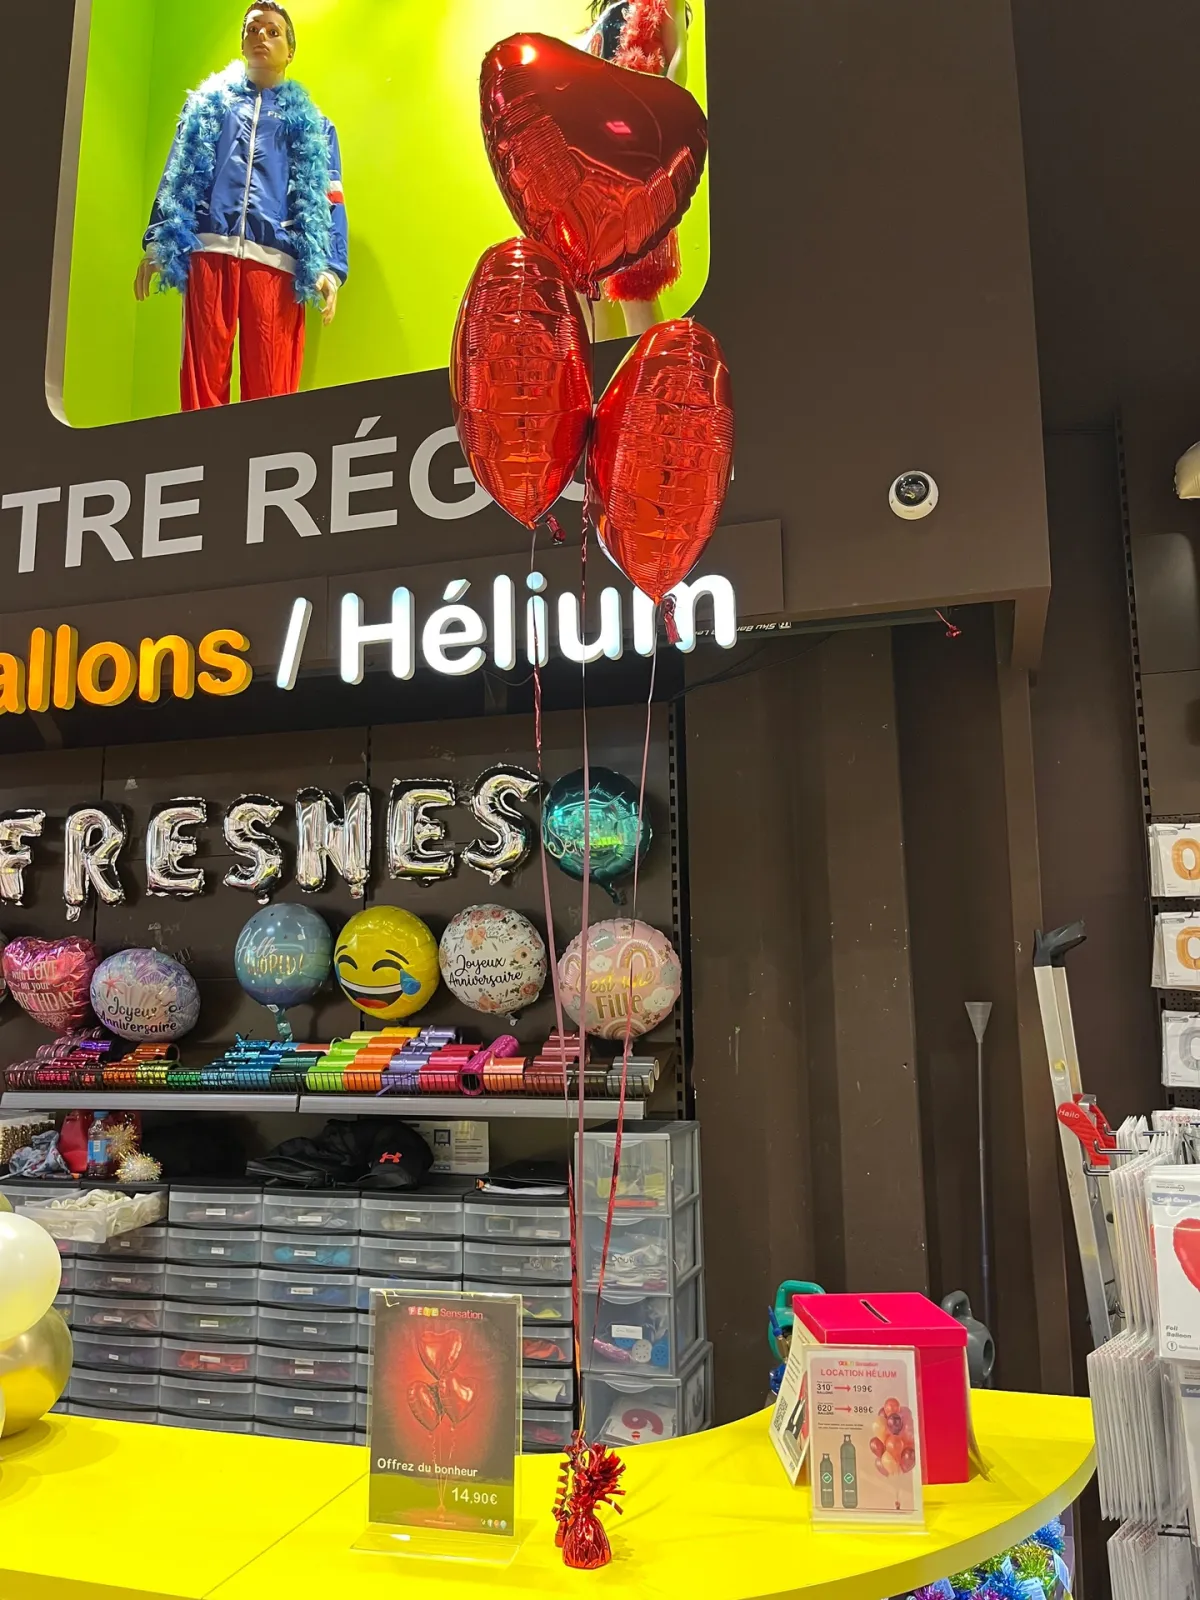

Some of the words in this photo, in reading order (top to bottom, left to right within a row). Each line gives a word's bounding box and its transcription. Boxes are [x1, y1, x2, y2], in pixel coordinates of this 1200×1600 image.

[1, 465, 204, 574] TRE
[340, 572, 738, 686] Hélium
[0, 762, 541, 908] FRESNES
[27, 960, 58, 981] LOVE
[454, 954, 507, 977] Joyeux
[31, 982, 50, 994] your
[448, 971, 524, 988] Anniversaire
[12, 989, 77, 1012] BIRTHDAY
[107, 996, 157, 1022] Joyeux
[596, 992, 643, 1019] Fille
[95, 1010, 177, 1035] Anniversaire
[1058, 1109, 1080, 1119] Hailo
[440, 1308, 484, 1320] Sensation
[820, 1368, 864, 1378] LOCATION
[865, 1369, 897, 1378] HÉLIUM
[853, 1385, 873, 1393] 199€
[853, 1406, 874, 1414] 389€
[377, 1457, 415, 1472] Offrez
[418, 1462, 431, 1473] du
[434, 1464, 479, 1478] bonheur
